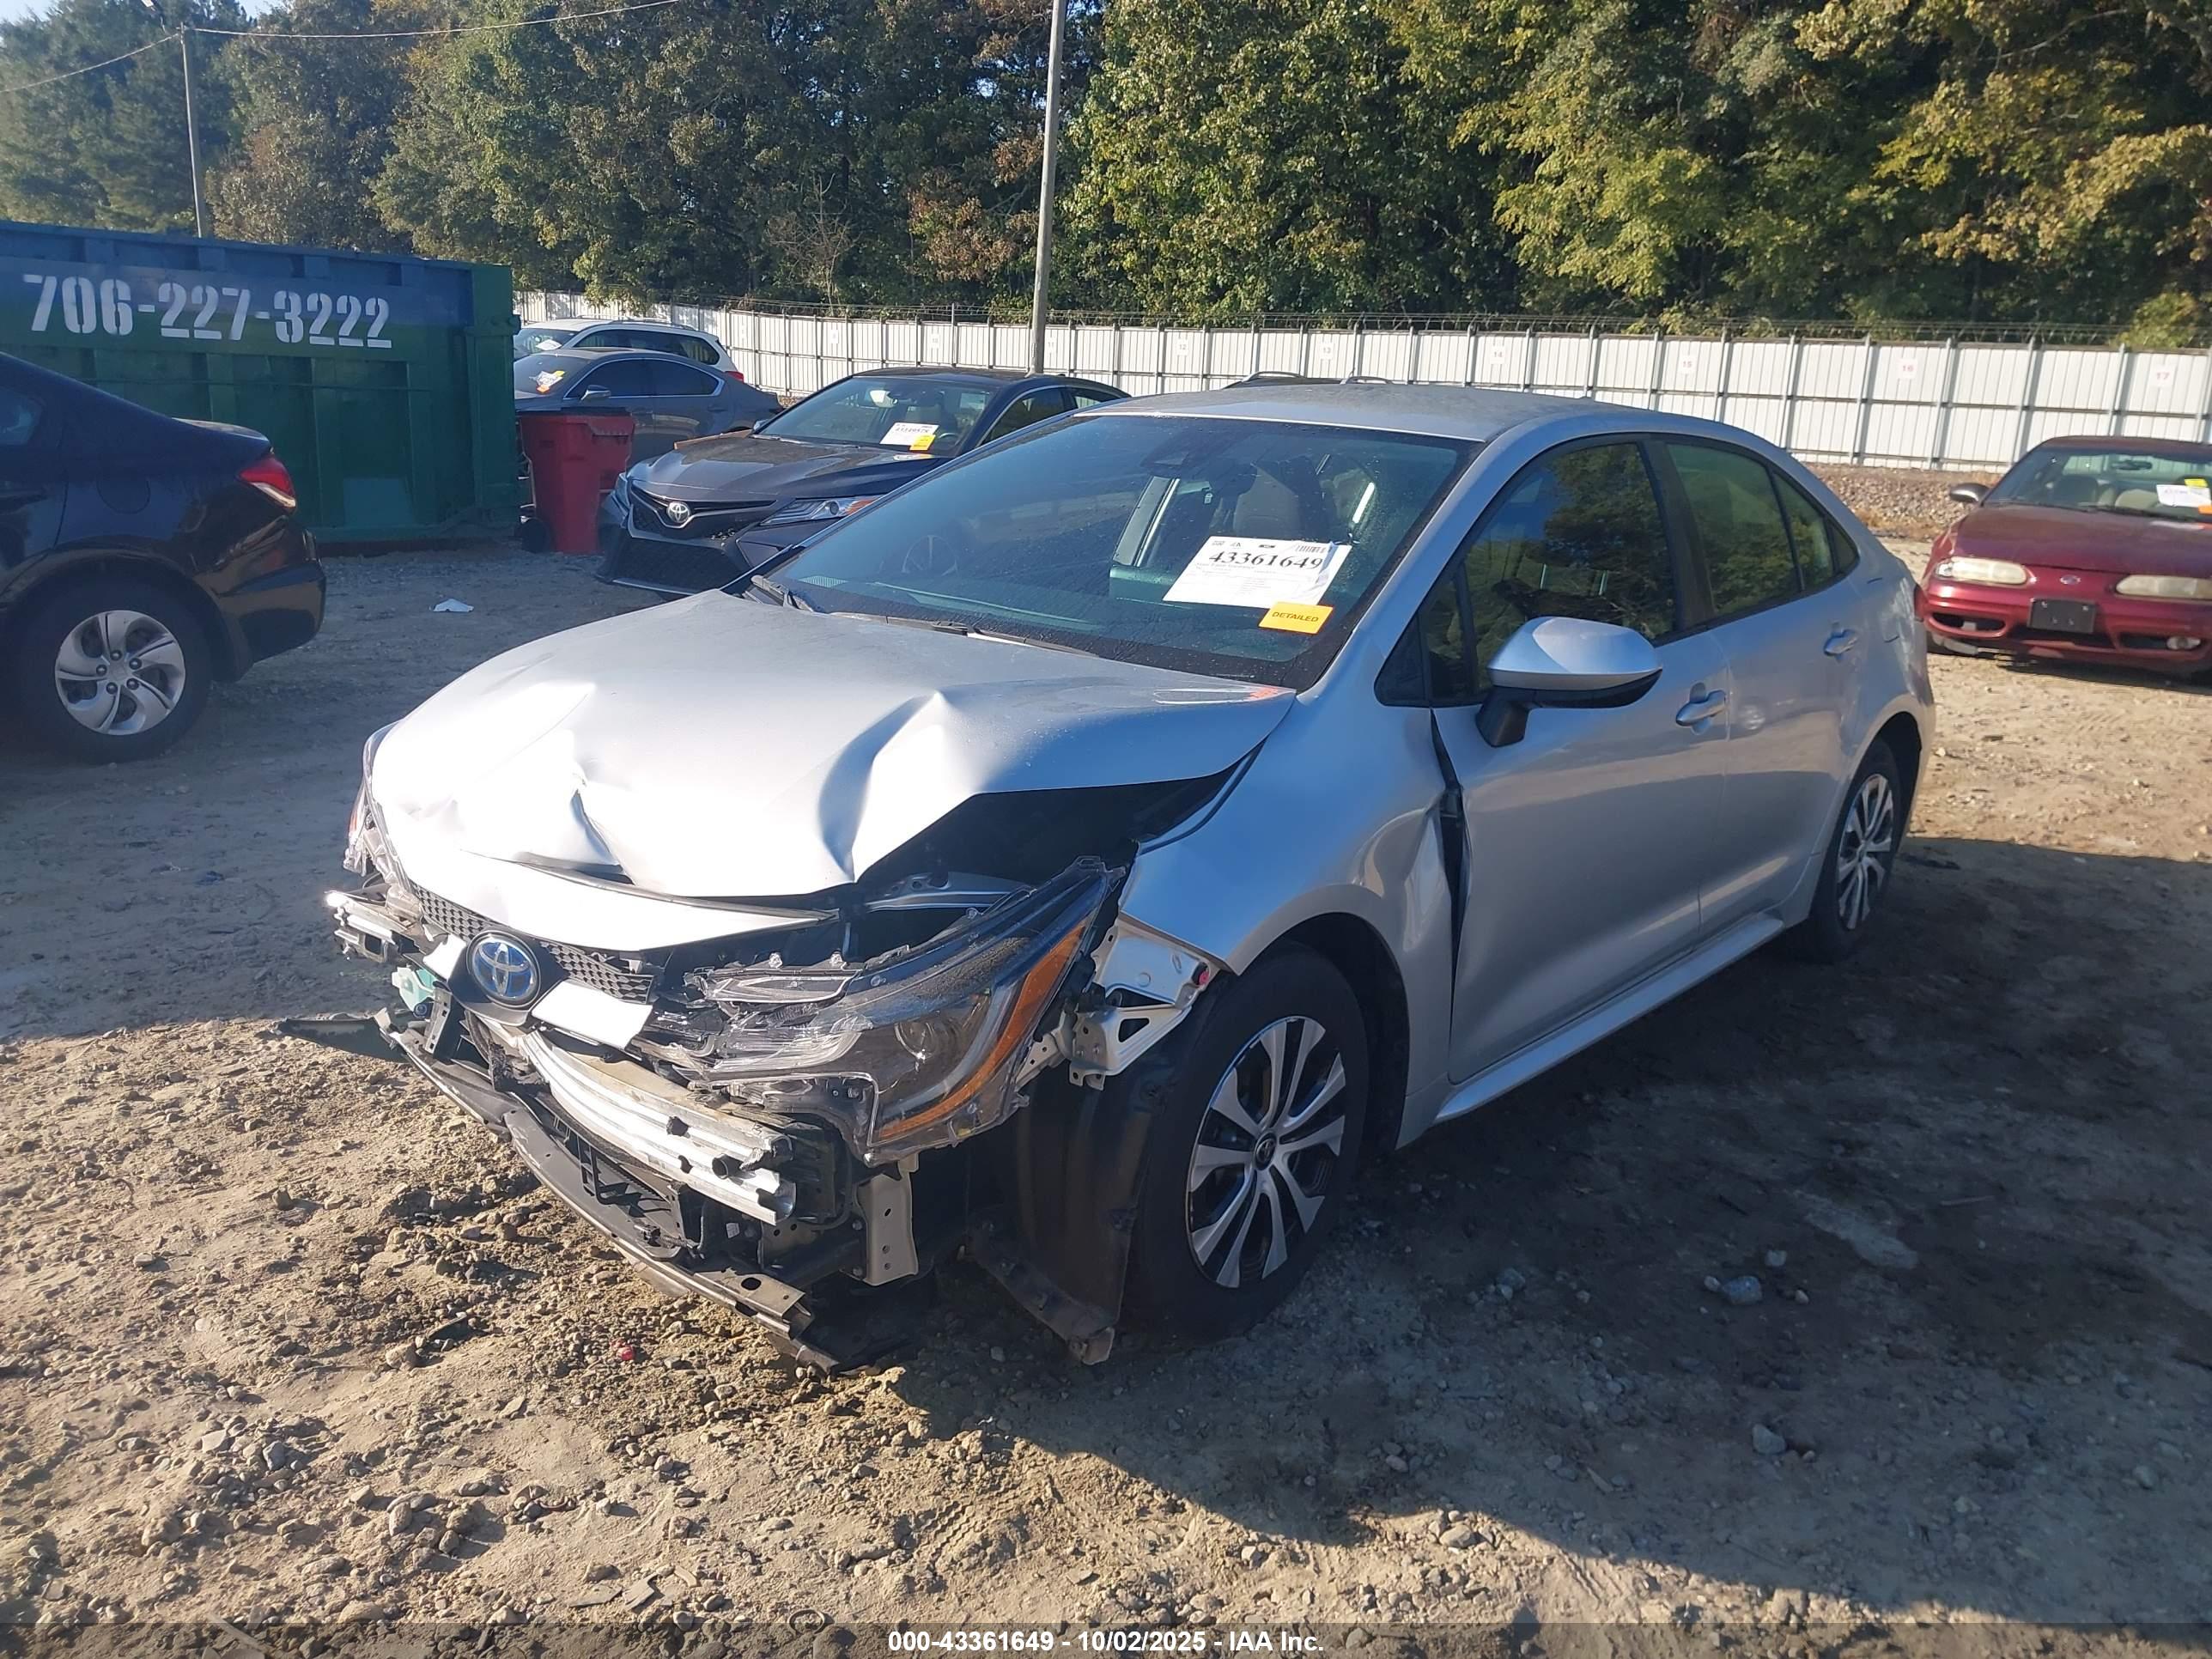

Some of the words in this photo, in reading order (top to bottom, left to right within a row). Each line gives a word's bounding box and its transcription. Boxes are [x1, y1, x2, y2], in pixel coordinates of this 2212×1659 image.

[23, 274, 392, 349] 706-227-3222
[2156, 372, 2170, 380] 17
[1208, 550, 1323, 569] 43361649
[1272, 611, 1320, 623] DETAILED
